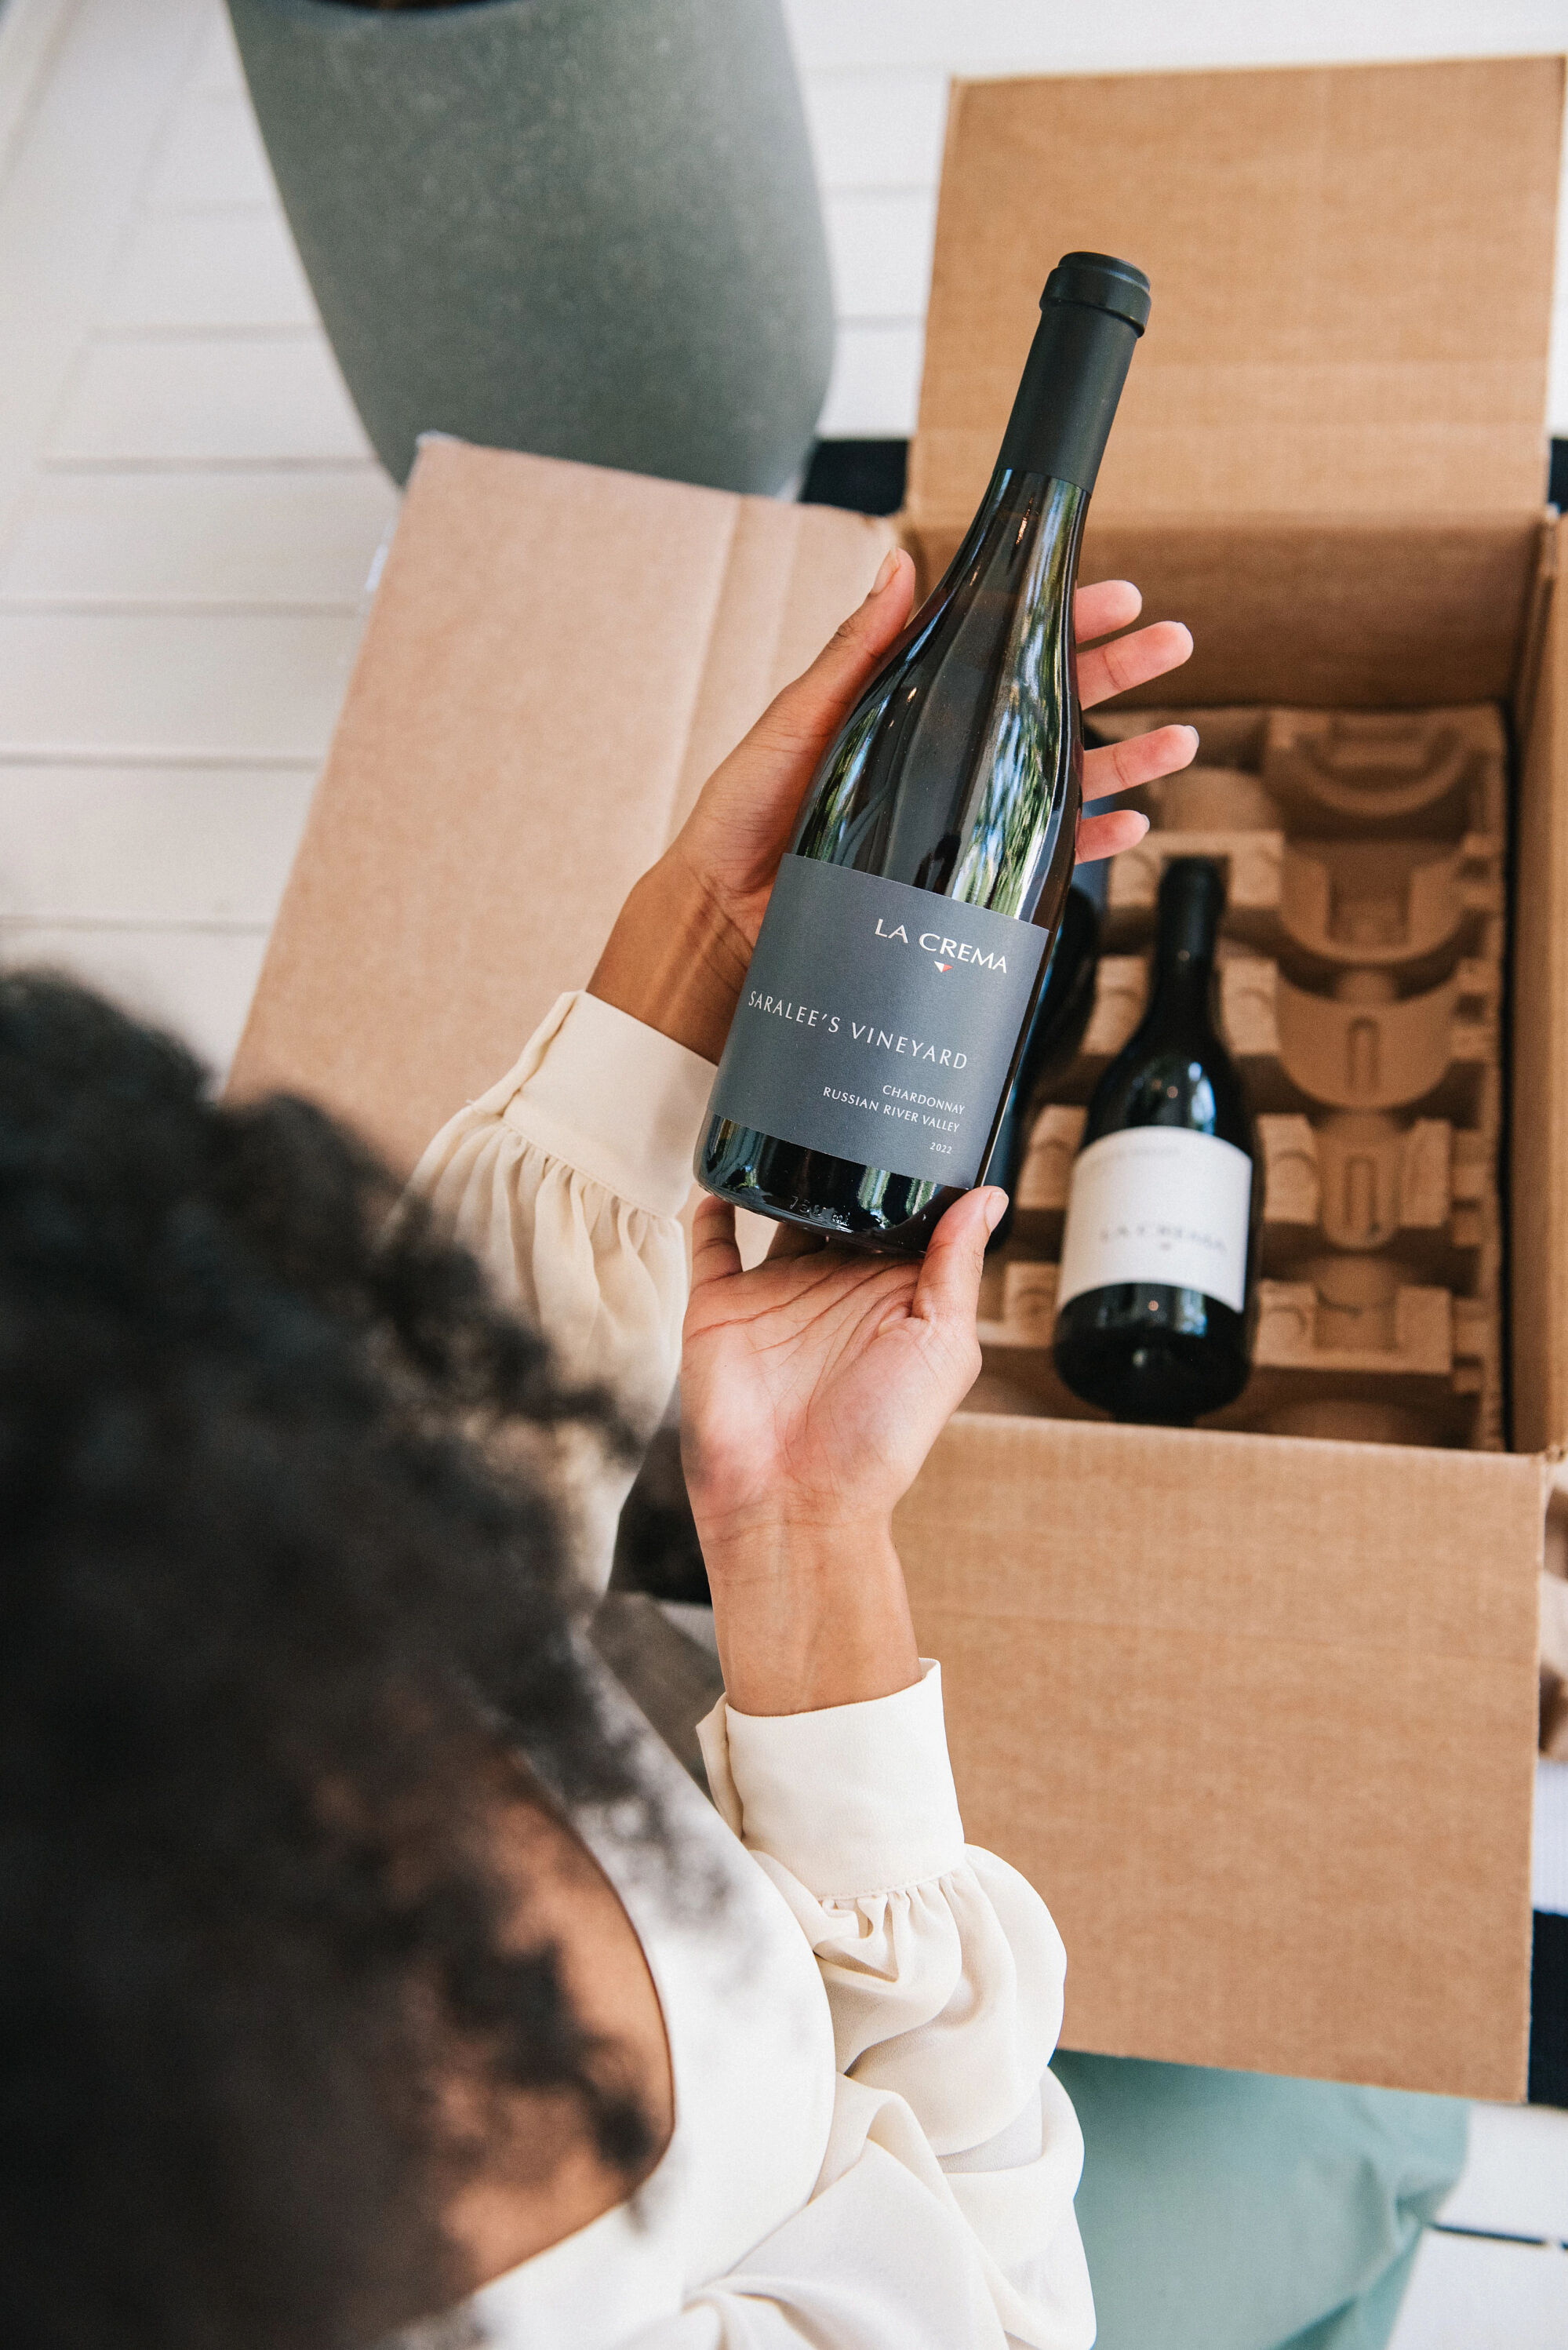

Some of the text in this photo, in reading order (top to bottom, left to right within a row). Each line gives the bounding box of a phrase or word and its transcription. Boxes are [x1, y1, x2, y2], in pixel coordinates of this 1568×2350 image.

[874, 918, 1007, 974] LA CREMA
[748, 990, 967, 1070] SARALEE'S VINEYARD
[822, 1086, 960, 1133] RUSSIAN RIVER VALLEY
[882, 1084, 966, 1115] CHARDONNAY
[930, 1141, 952, 1155] 2022
